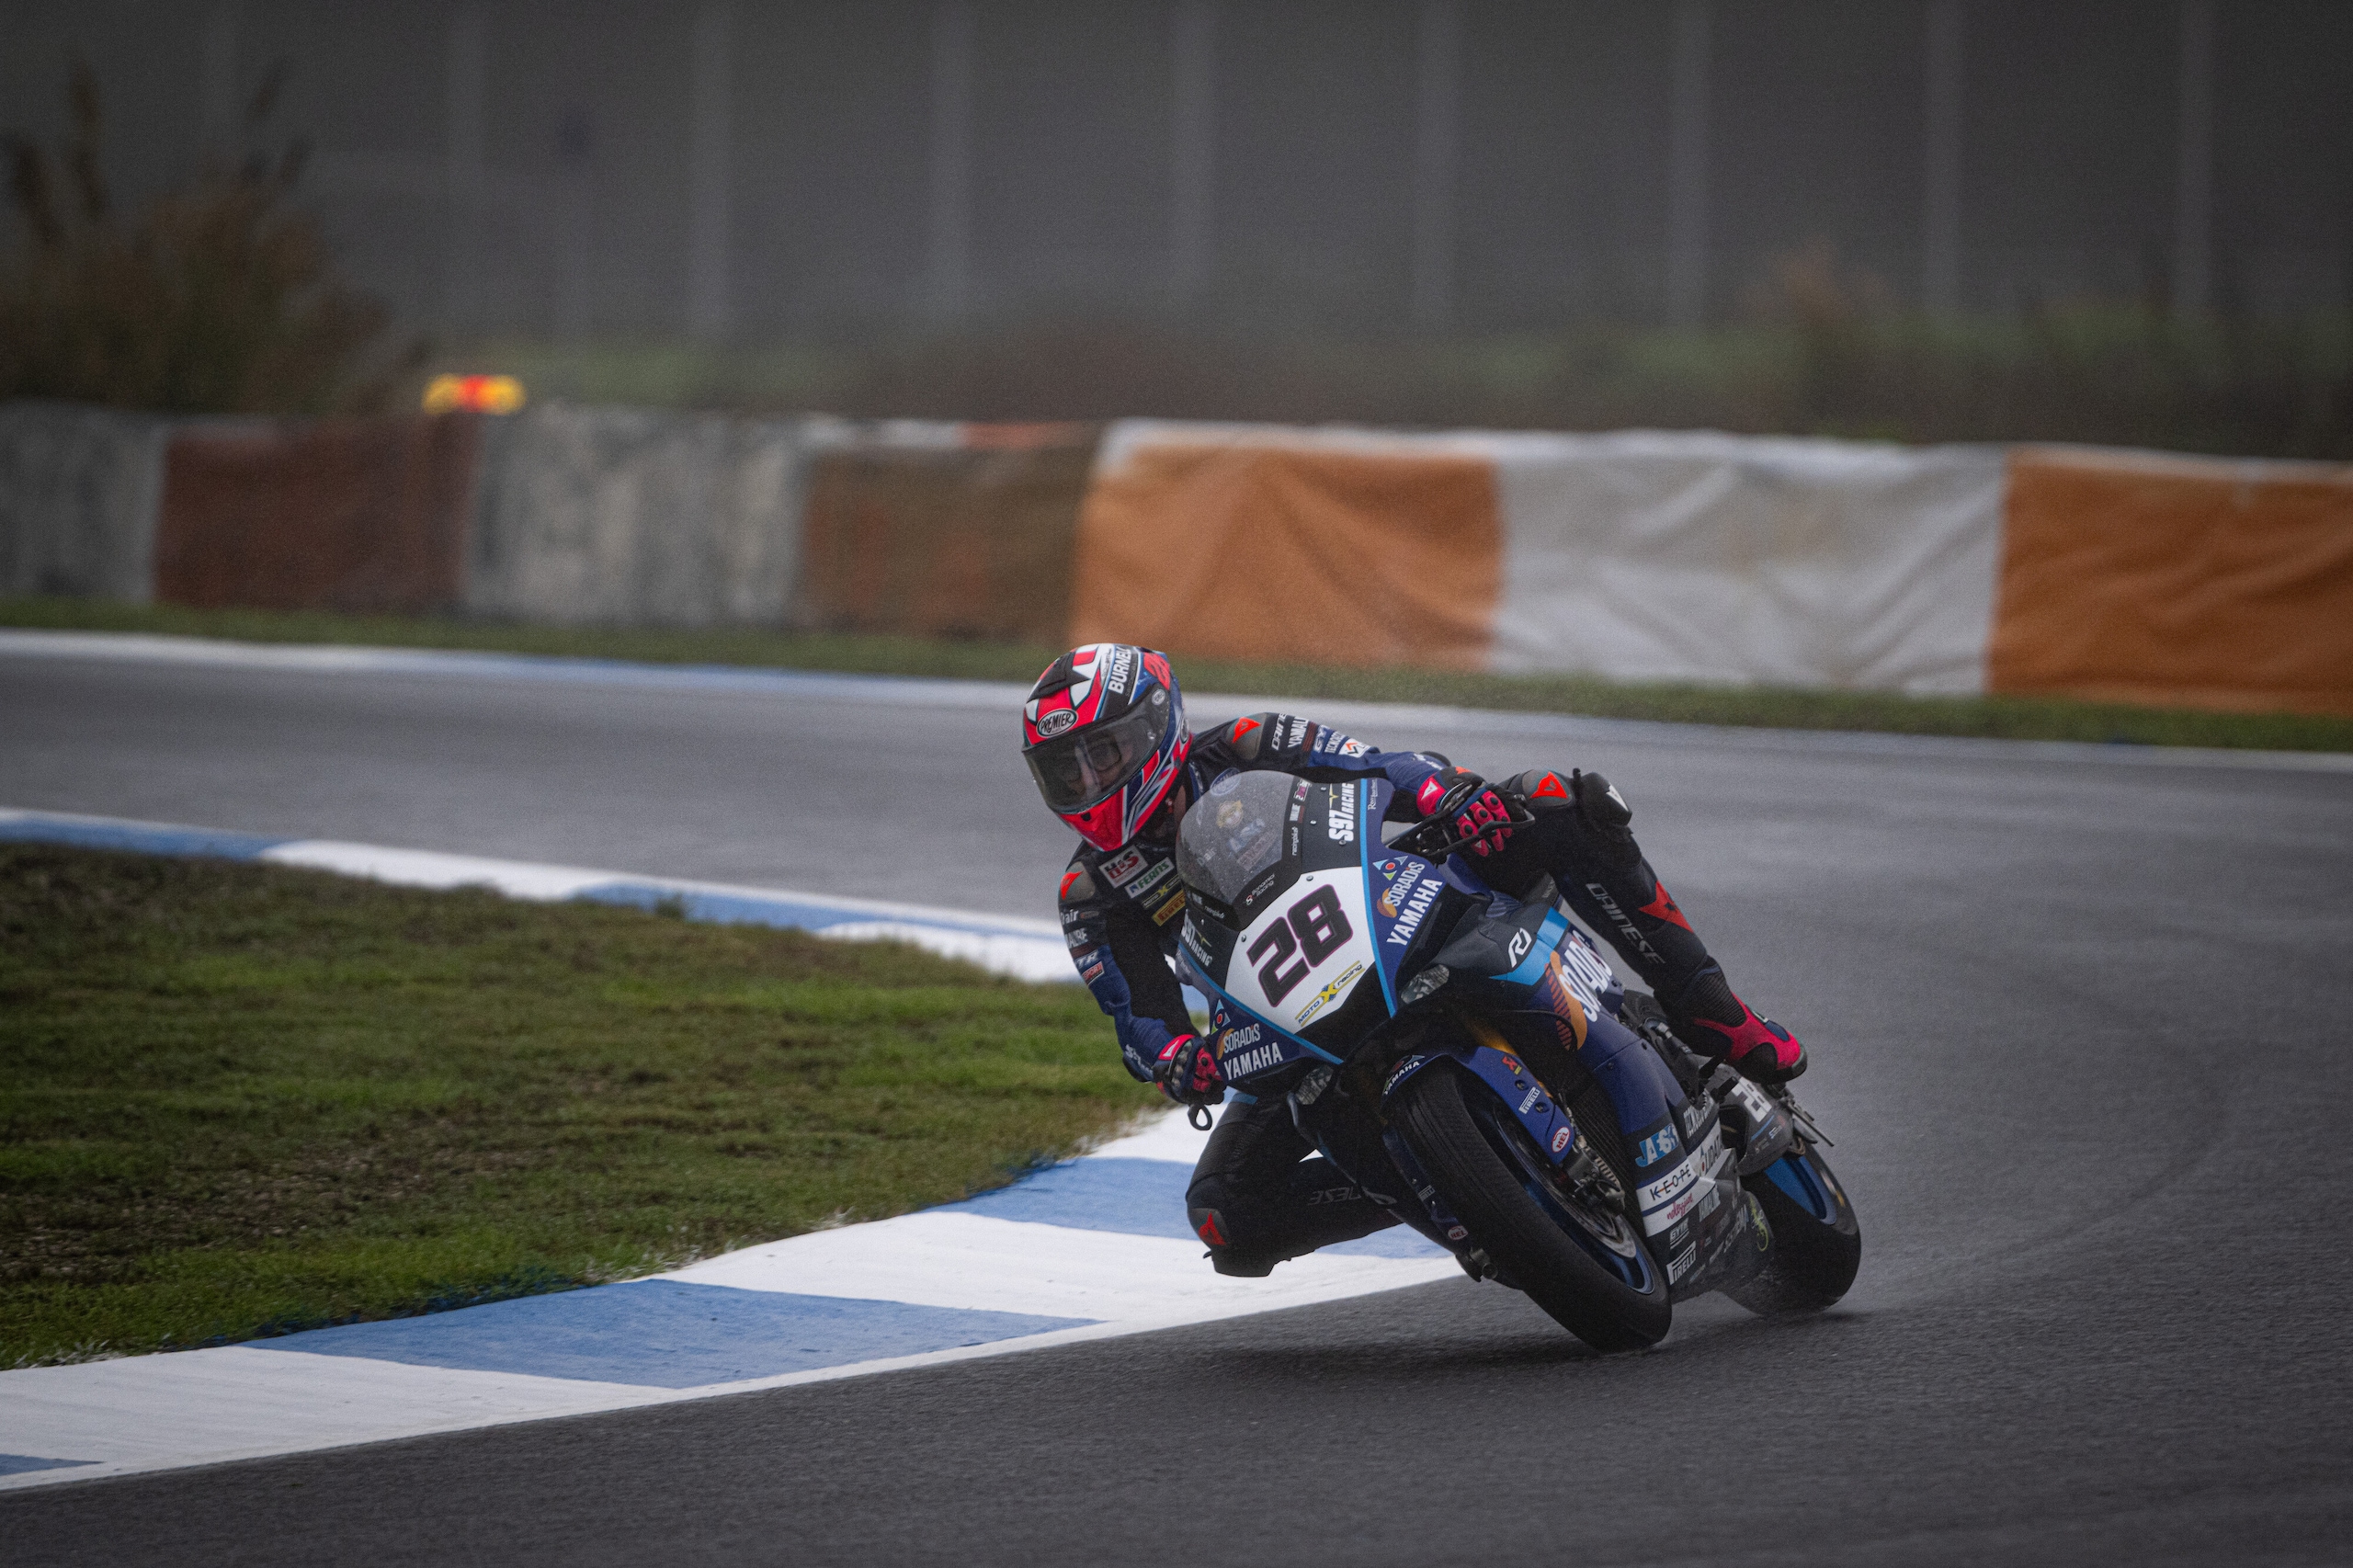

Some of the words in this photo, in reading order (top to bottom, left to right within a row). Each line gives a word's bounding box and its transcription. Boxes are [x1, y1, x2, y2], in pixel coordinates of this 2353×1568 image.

[1040, 713, 1073, 733] PREMIER
[1341, 782, 1355, 814] RACING
[1328, 809, 1355, 842] S97
[1386, 879, 1443, 946] YAMAHA
[1586, 883, 1666, 964] DAINESE
[1246, 884, 1354, 1008] 28
[1298, 1000, 1321, 1024] MOTO
[1337, 963, 1363, 986] racing
[1223, 1041, 1283, 1081] YAMAHA
[1383, 1061, 1421, 1096] YAMAHA
[1518, 1086, 1540, 1115] PIRELLI
[1555, 1131, 1570, 1151] HEL
[1649, 1163, 1692, 1201] KEOPE
[1449, 1229, 1468, 1240] HEL
[1665, 1240, 1697, 1286] PIRELLI
